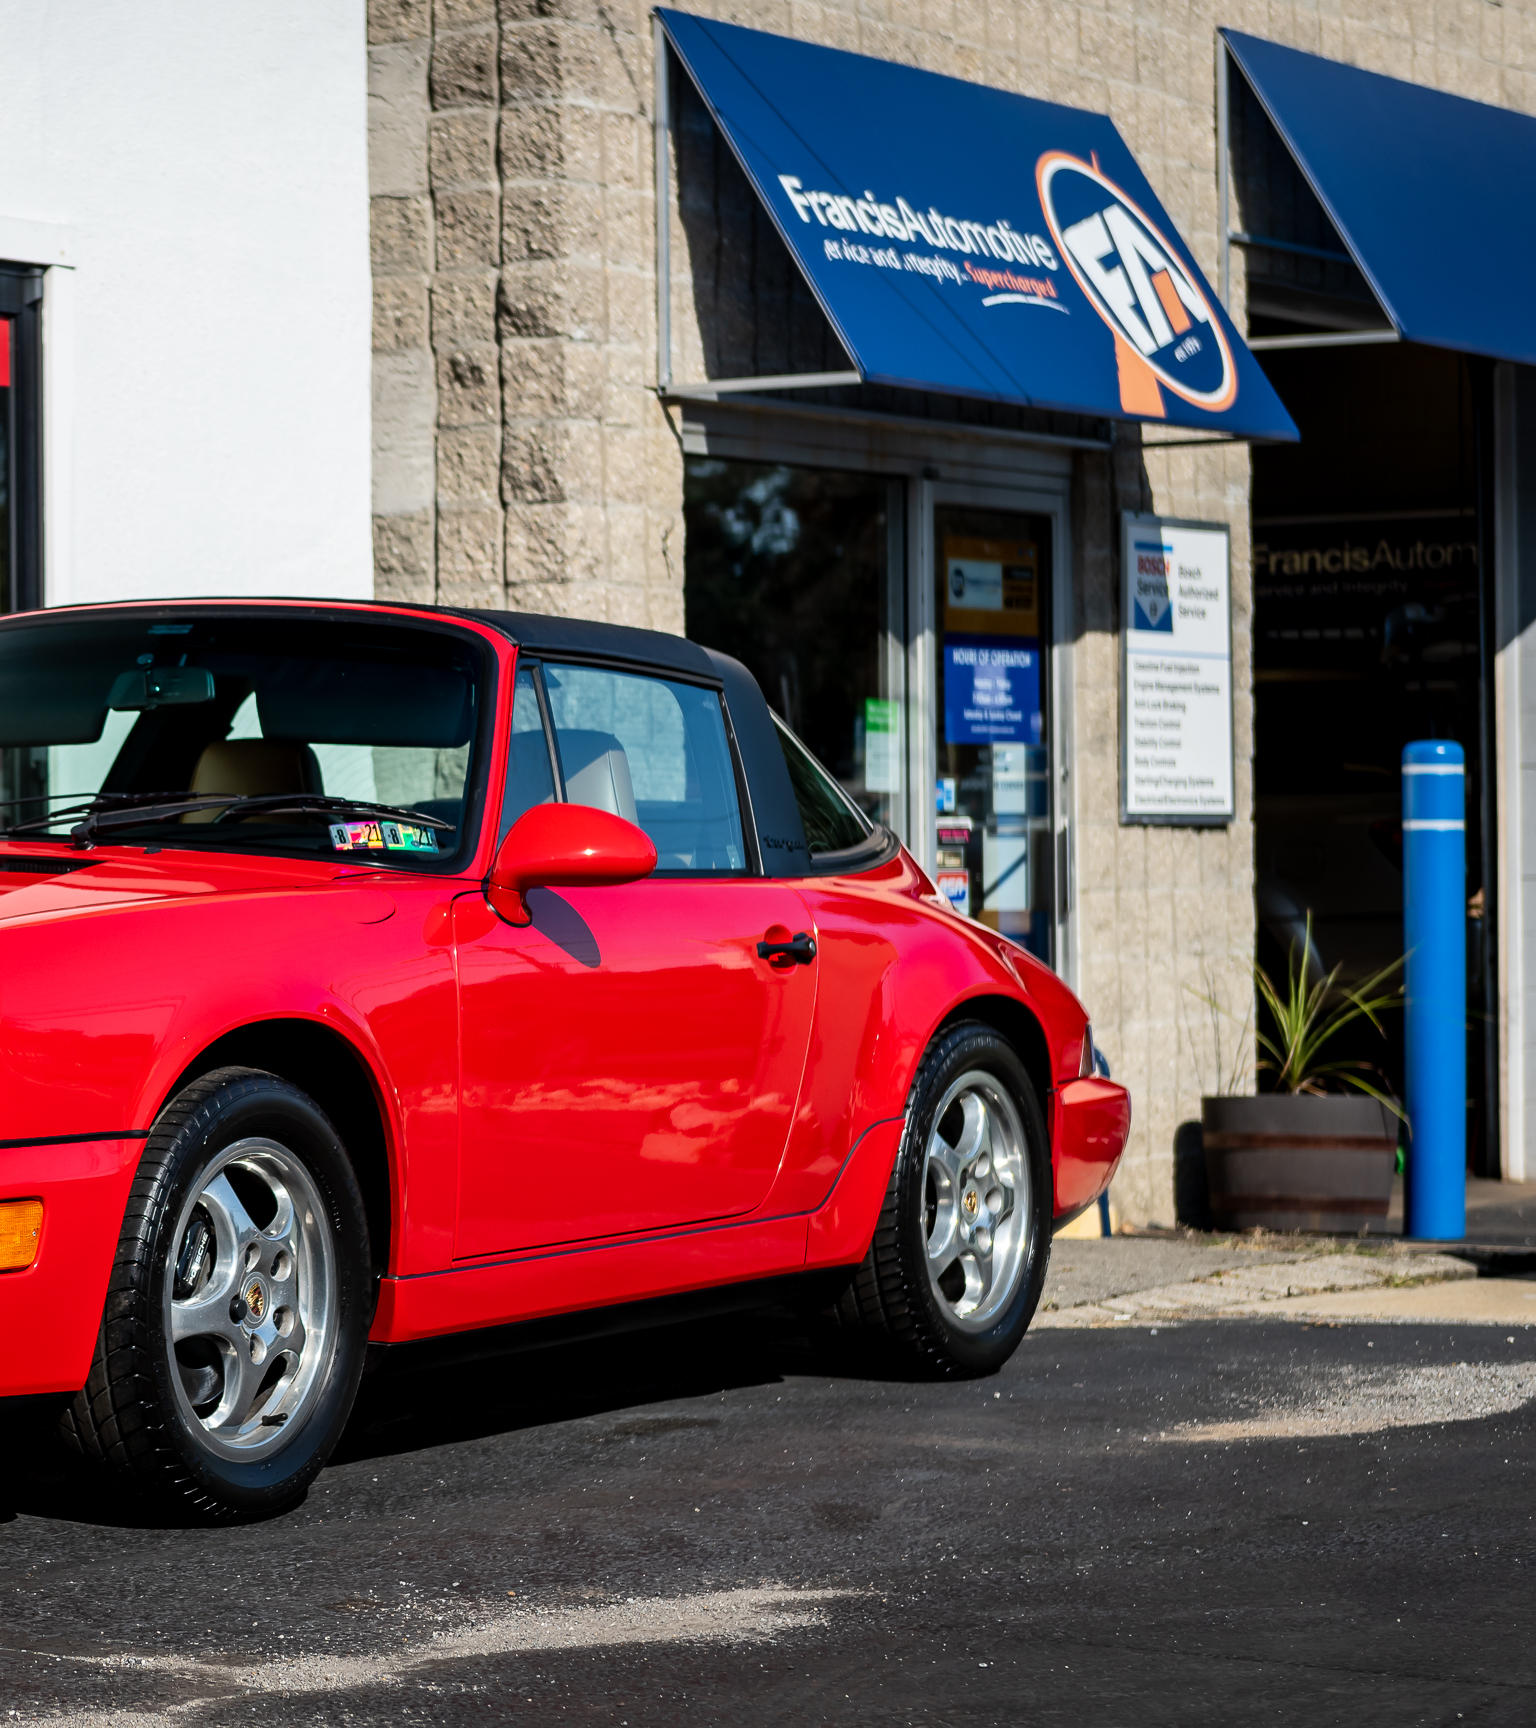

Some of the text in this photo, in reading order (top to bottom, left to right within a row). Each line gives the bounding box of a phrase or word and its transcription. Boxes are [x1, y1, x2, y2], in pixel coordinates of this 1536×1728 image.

[777, 174, 1060, 271] FrancisAutomotive
[963, 260, 1058, 299] Supercharged
[1137, 555, 1170, 577] BOSCH
[1178, 602, 1206, 620] Service
[953, 648, 1031, 668] HOURS OF OPERATION
[187, 1231, 209, 1287] POSCHE
